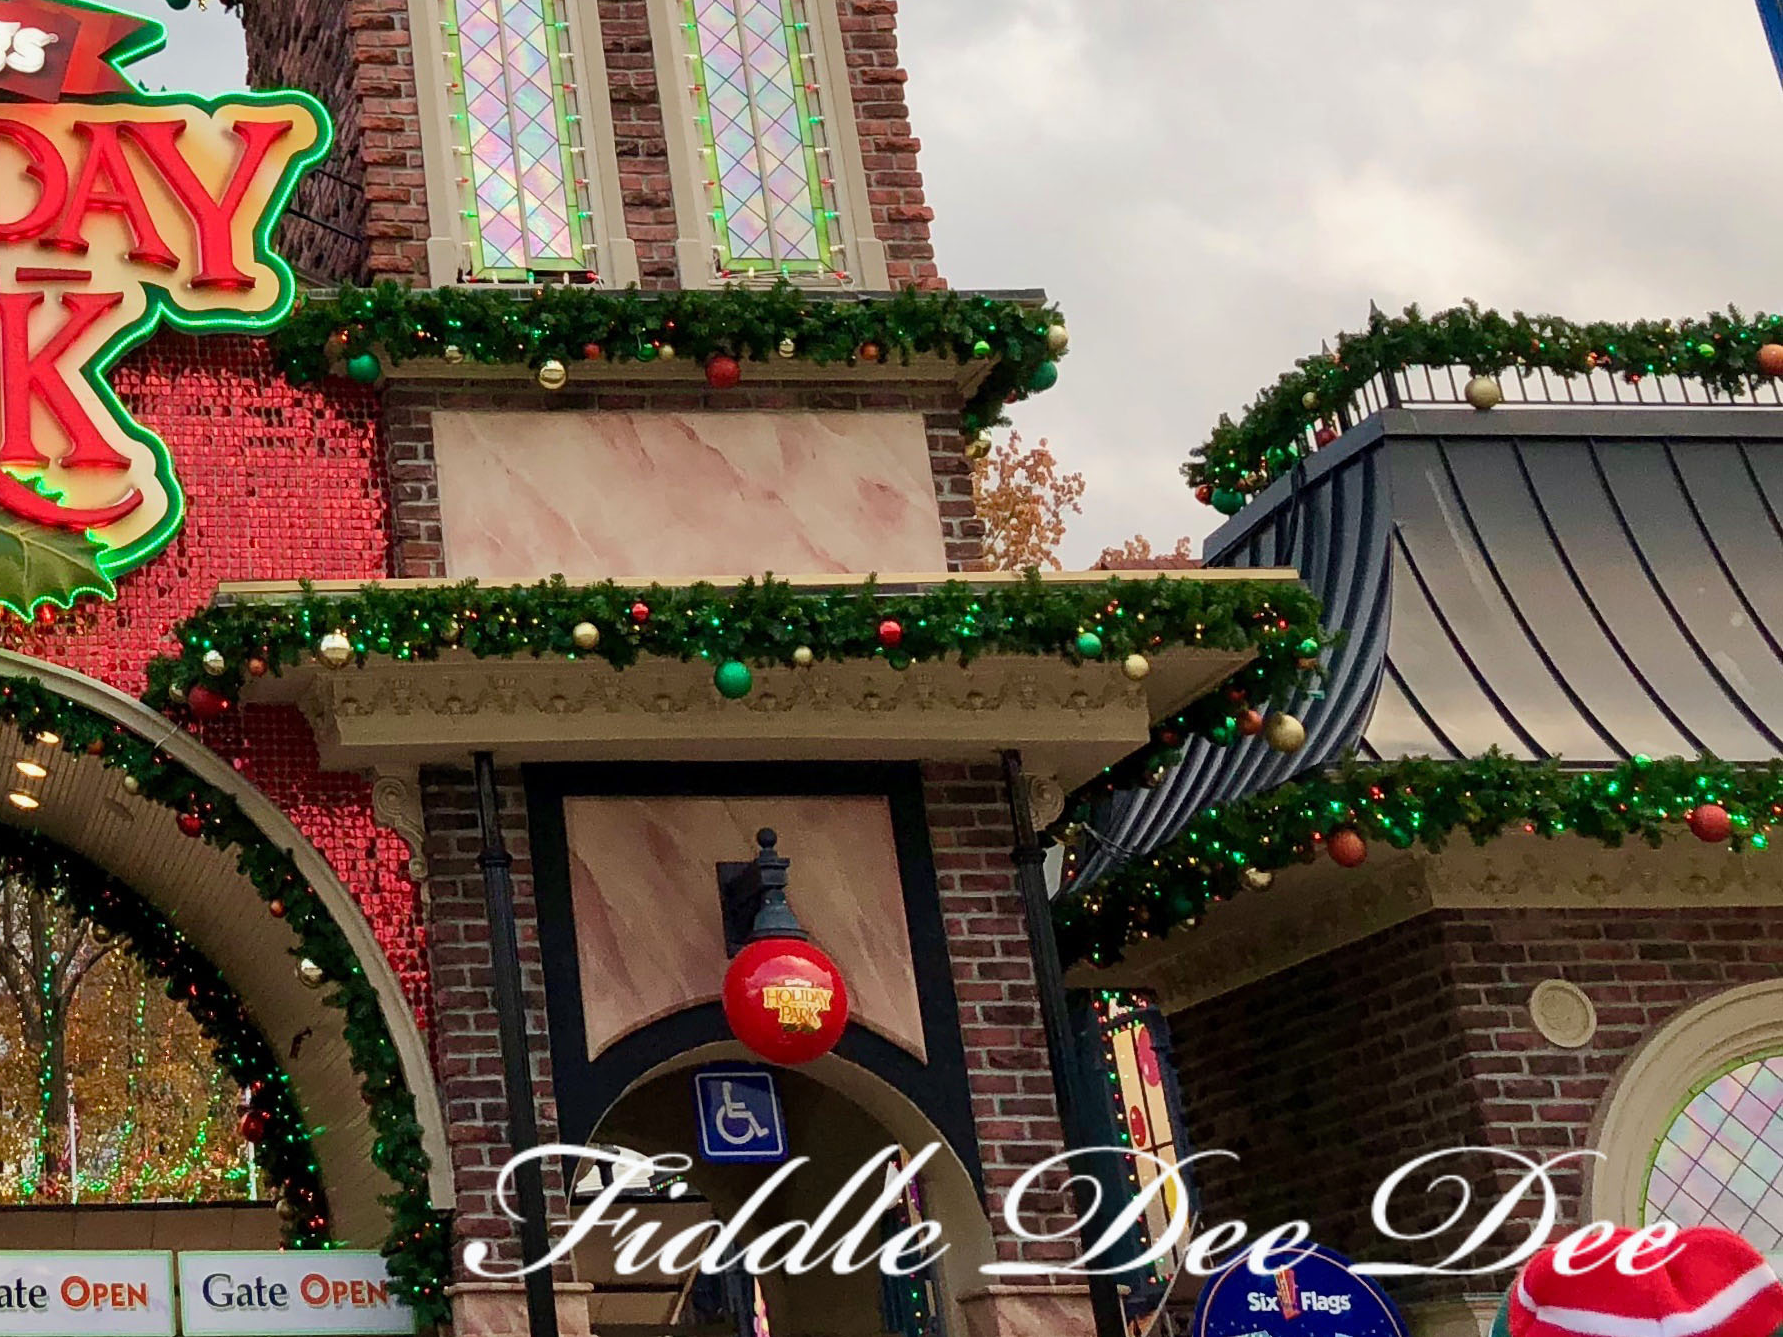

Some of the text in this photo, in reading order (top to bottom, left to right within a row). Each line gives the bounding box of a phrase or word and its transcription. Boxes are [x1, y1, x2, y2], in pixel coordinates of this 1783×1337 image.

[764, 987, 831, 1010] HOLIDAY
[781, 1005, 821, 1026] PARK
[60, 1275, 148, 1306] OPEN
[202, 1273, 388, 1307] Gate OPEN
[1247, 1291, 1351, 1314] Six Flags
